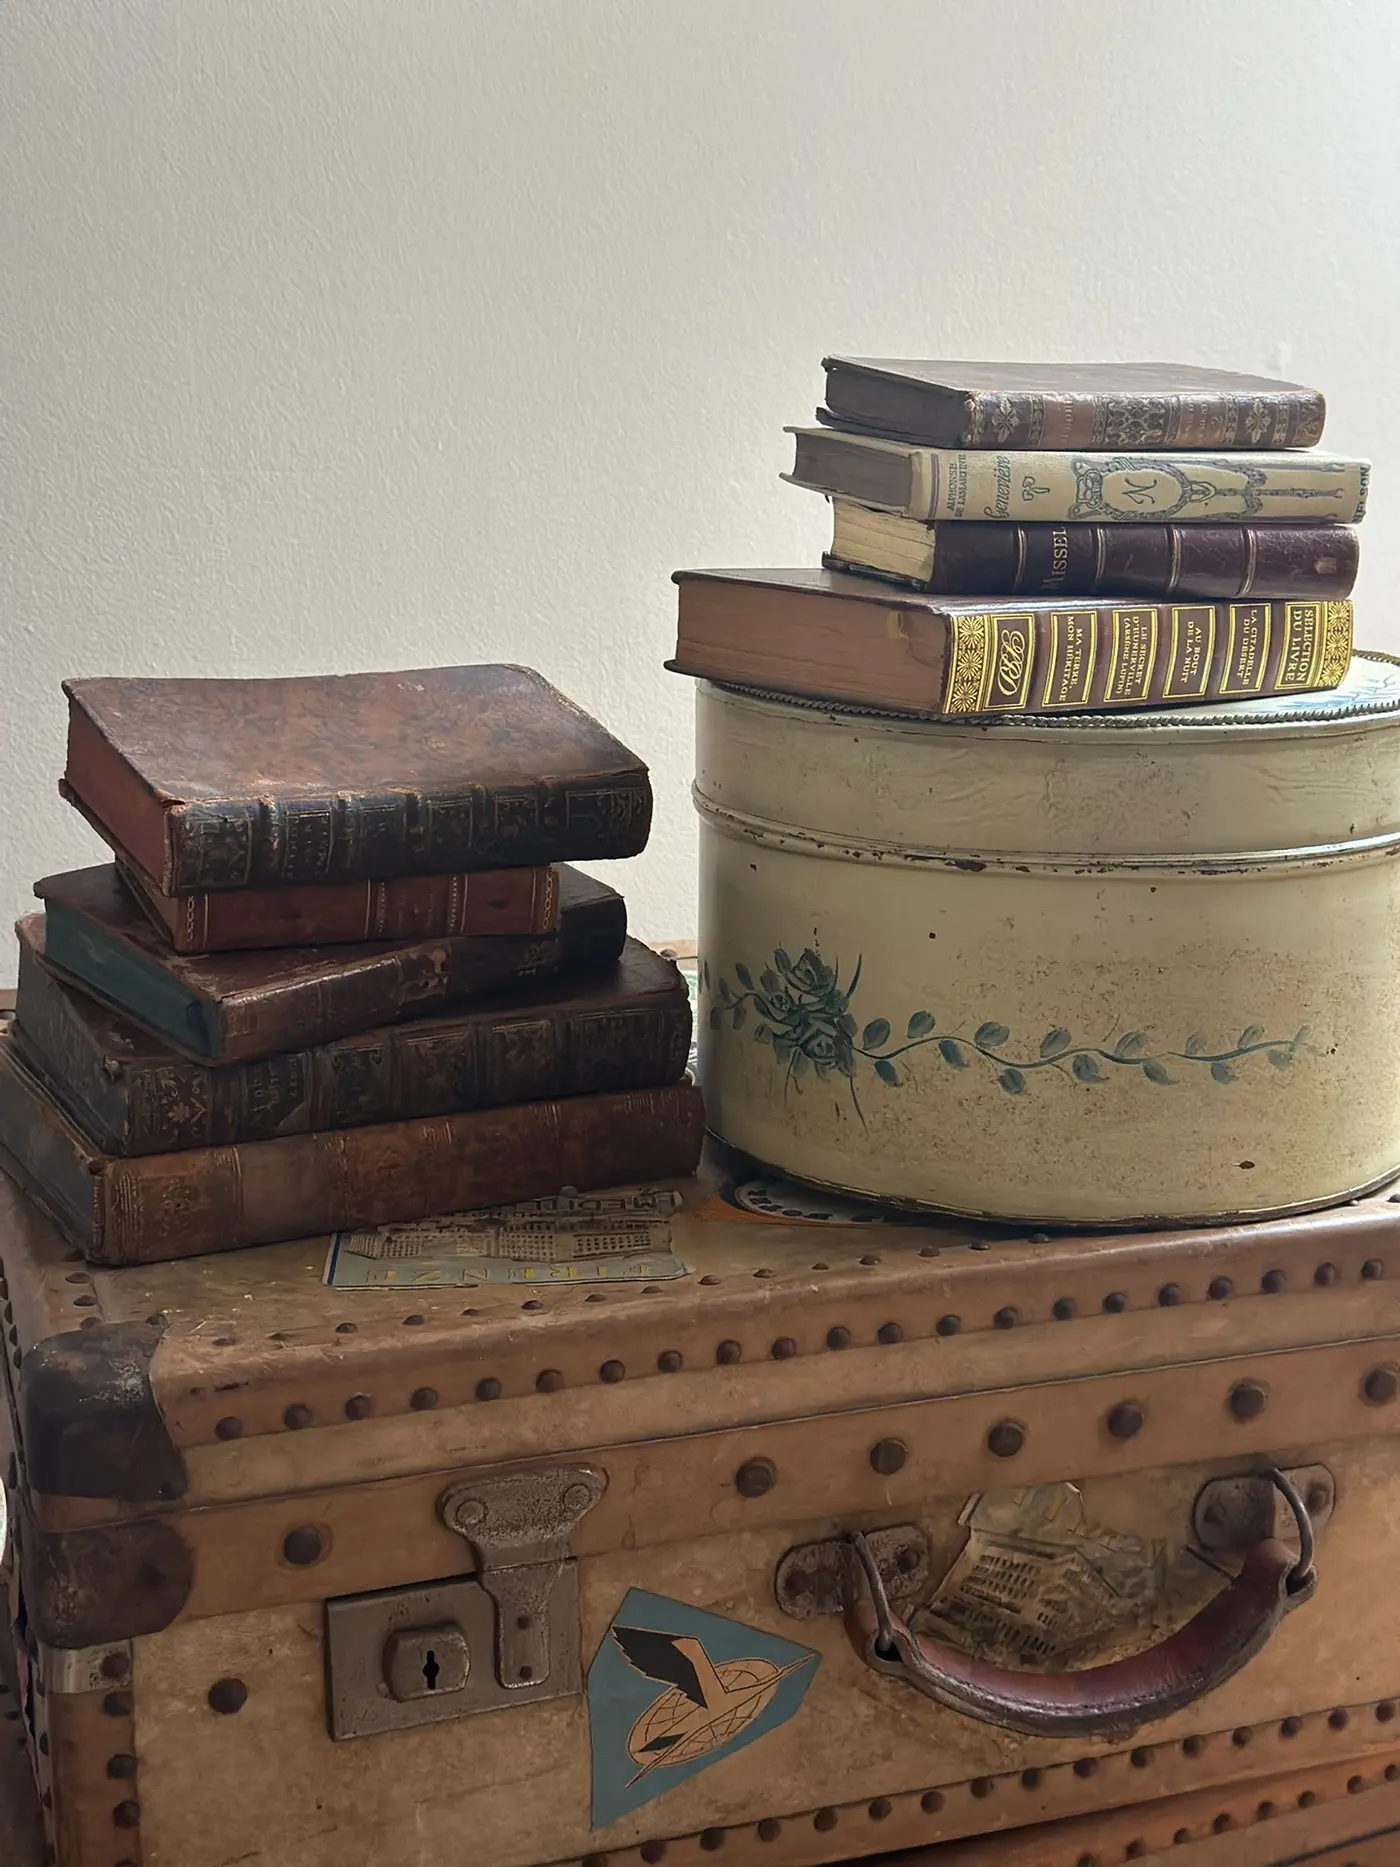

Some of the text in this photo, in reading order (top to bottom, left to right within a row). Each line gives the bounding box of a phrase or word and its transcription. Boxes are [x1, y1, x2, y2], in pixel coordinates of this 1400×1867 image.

[946, 463, 958, 512] ALPHONSE
[954, 454, 967, 517] DE LAMARTINE
[1121, 477, 1158, 505] N
[1067, 615, 1075, 641] MON
[1075, 628, 1083, 646] MA
[1242, 609, 1257, 686] LA CITADELLE
[1243, 618, 1250, 634] DU
[1285, 610, 1302, 682] DU LIVRE
[1134, 626, 1148, 685] LE SECRET
[1180, 621, 1196, 683] DE LA NUIT
[1190, 627, 1202, 676] AU BOUT
[1115, 663, 1128, 695] LUPIN)
